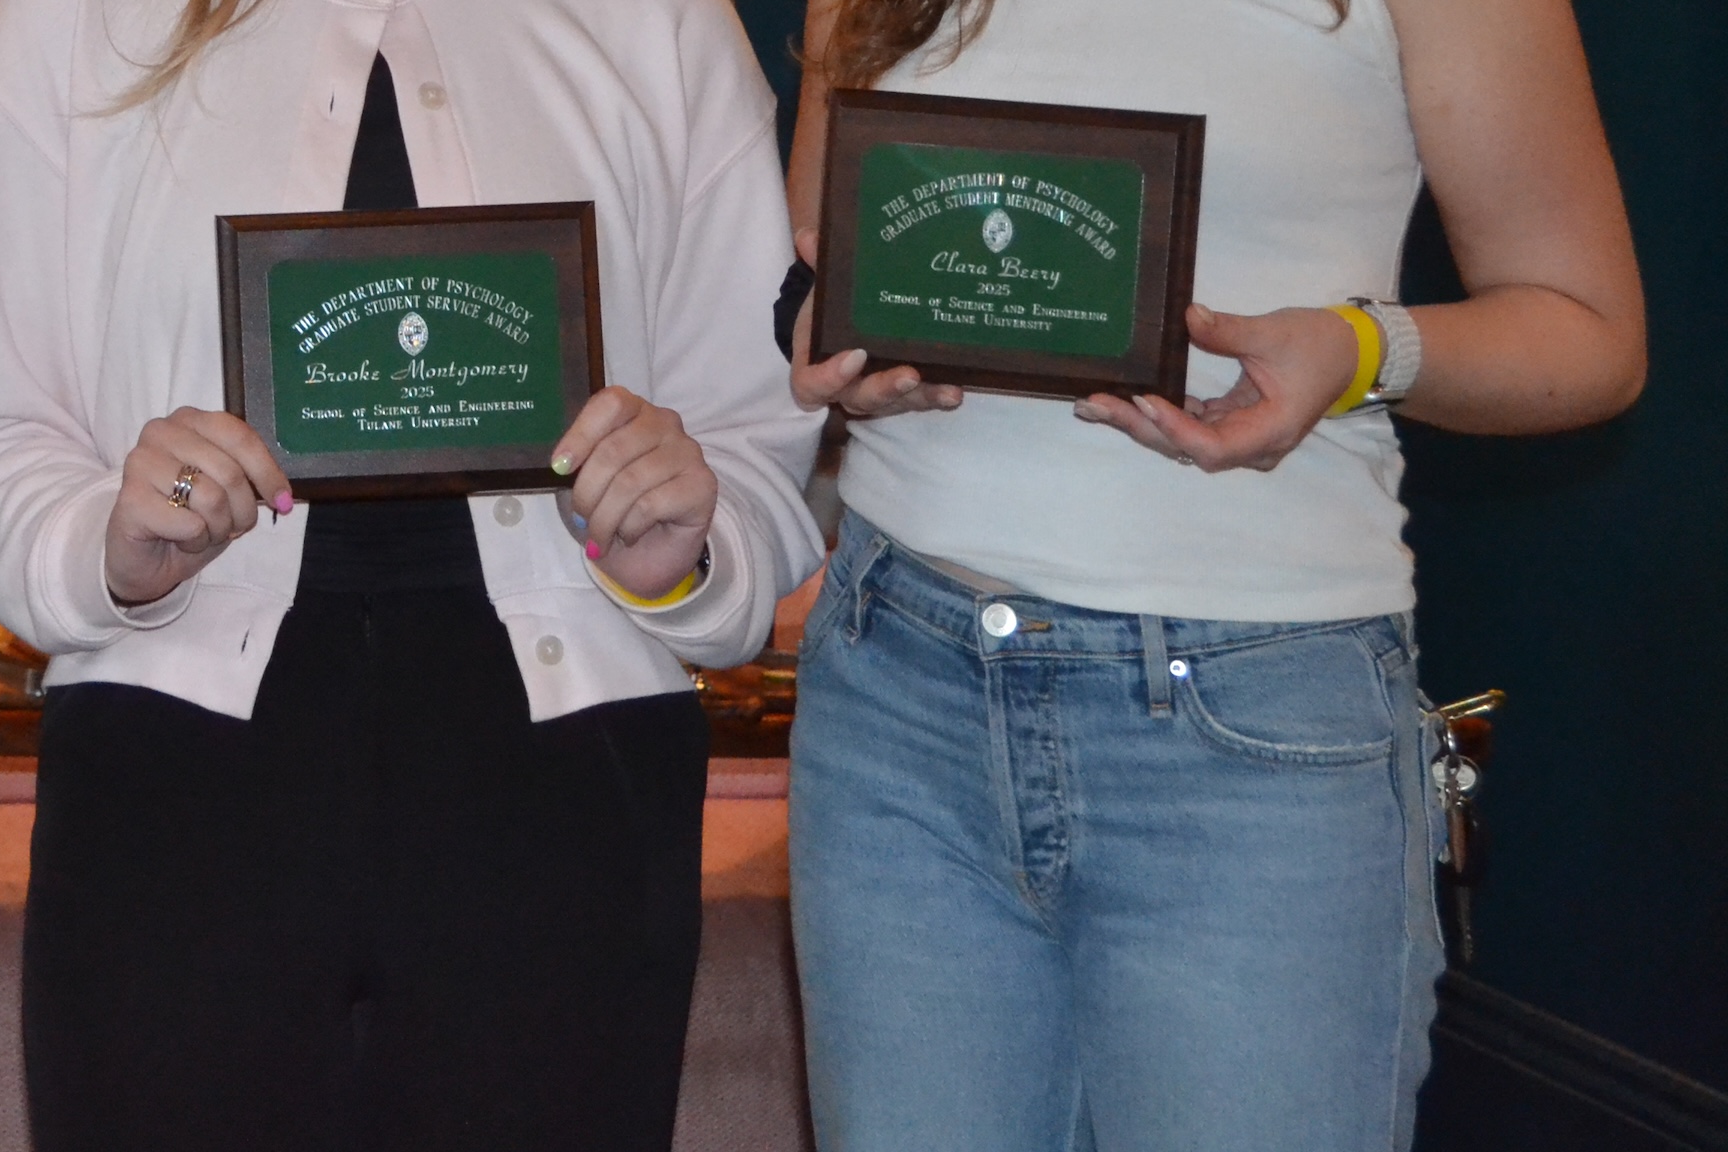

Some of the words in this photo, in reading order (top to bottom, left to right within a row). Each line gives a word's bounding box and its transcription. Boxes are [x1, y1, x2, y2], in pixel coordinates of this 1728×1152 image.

[881, 196, 909, 218] THE
[913, 173, 1005, 201] DEPARTMENT
[1012, 175, 1030, 189] OF
[1036, 180, 1119, 234] PSYCHOLOGY
[880, 202, 941, 242] GRADUATE
[945, 192, 999, 210] STUDENT
[1006, 194, 1075, 226] MENTORING
[1074, 221, 1117, 261] AWARD
[930, 251, 988, 275] Clara
[292, 313, 320, 335] THE
[322, 277, 414, 315] DEPARTMENT
[422, 276, 439, 290] OF
[447, 279, 534, 325] PSYCHOLOGY
[977, 283, 1011, 296] 2025
[299, 312, 361, 354] GRADUATE
[364, 295, 421, 316] STUDENT
[427, 295, 481, 319] SERVICE
[484, 314, 530, 345] AWARD
[305, 360, 380, 384] Brooke
[390, 359, 529, 385] Montgomery
[401, 386, 434, 399] 2025
